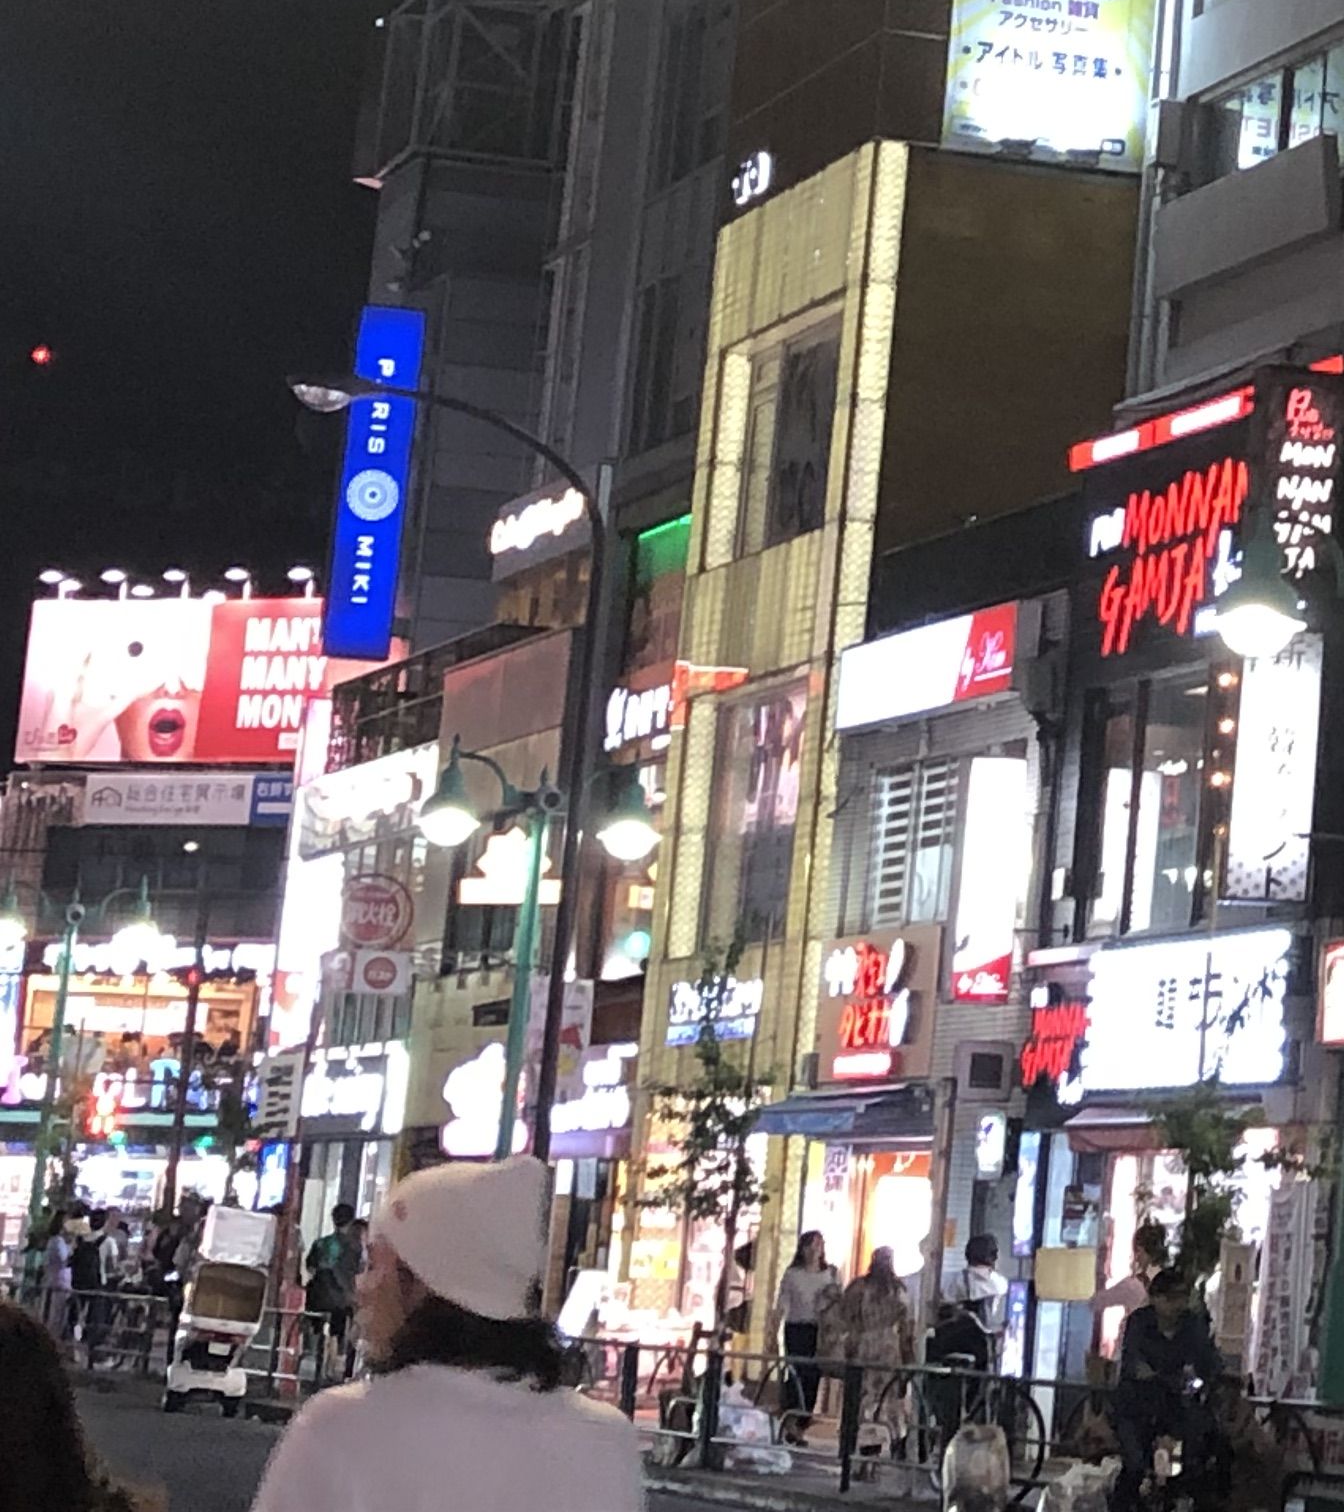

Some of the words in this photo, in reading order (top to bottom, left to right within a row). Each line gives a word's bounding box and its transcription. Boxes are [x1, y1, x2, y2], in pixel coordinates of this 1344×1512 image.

[998, 10, 1089, 35] アクセサリー
[359, 358, 395, 454] PRIS
[351, 535, 374, 604] MIKI
[1100, 535, 1207, 656] GAMJA
[239, 655, 327, 691] MANY
